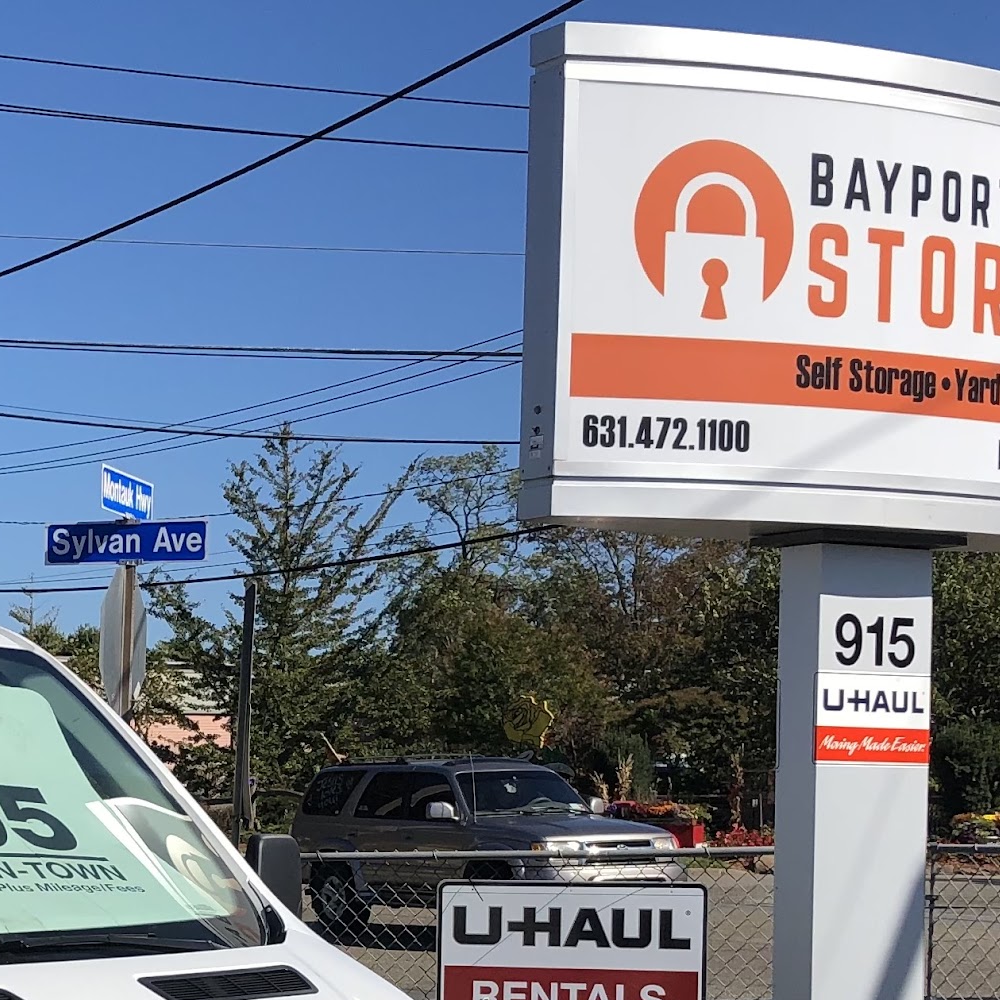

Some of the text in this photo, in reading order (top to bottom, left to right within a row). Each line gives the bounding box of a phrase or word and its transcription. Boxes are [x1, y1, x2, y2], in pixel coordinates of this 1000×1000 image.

[810, 152, 1000, 229] BAYPOR
[807, 222, 1000, 337] STOR
[796, 354, 842, 391] Self
[849, 358, 936, 402] Storage
[582, 414, 750, 453] 631.472.1100
[103, 471, 151, 520] Montauk Hwy
[52, 526, 203, 560] Sylvan Ave
[835, 613, 915, 668] 915
[823, 688, 924, 714] U-HAUL
[819, 734, 858, 756] Moving
[857, 736, 891, 752] Made
[453, 905, 692, 950] U-HAUL
